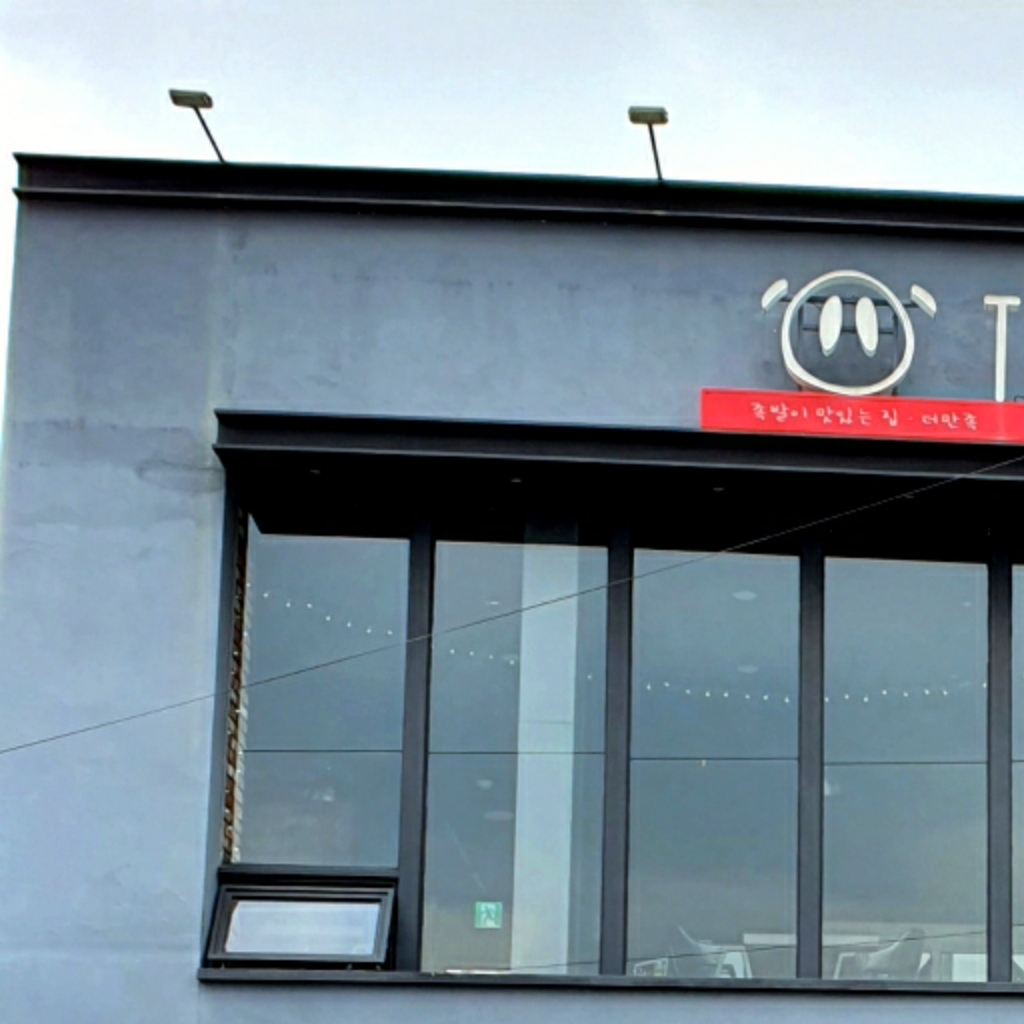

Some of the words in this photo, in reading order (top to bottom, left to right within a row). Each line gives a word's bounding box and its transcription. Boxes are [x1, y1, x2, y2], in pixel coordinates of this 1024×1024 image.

[751, 401, 809, 423] 족발이
[816, 404, 872, 426] 맛있는
[880, 407, 898, 427] 집
[921, 411, 978, 431] 더만족
